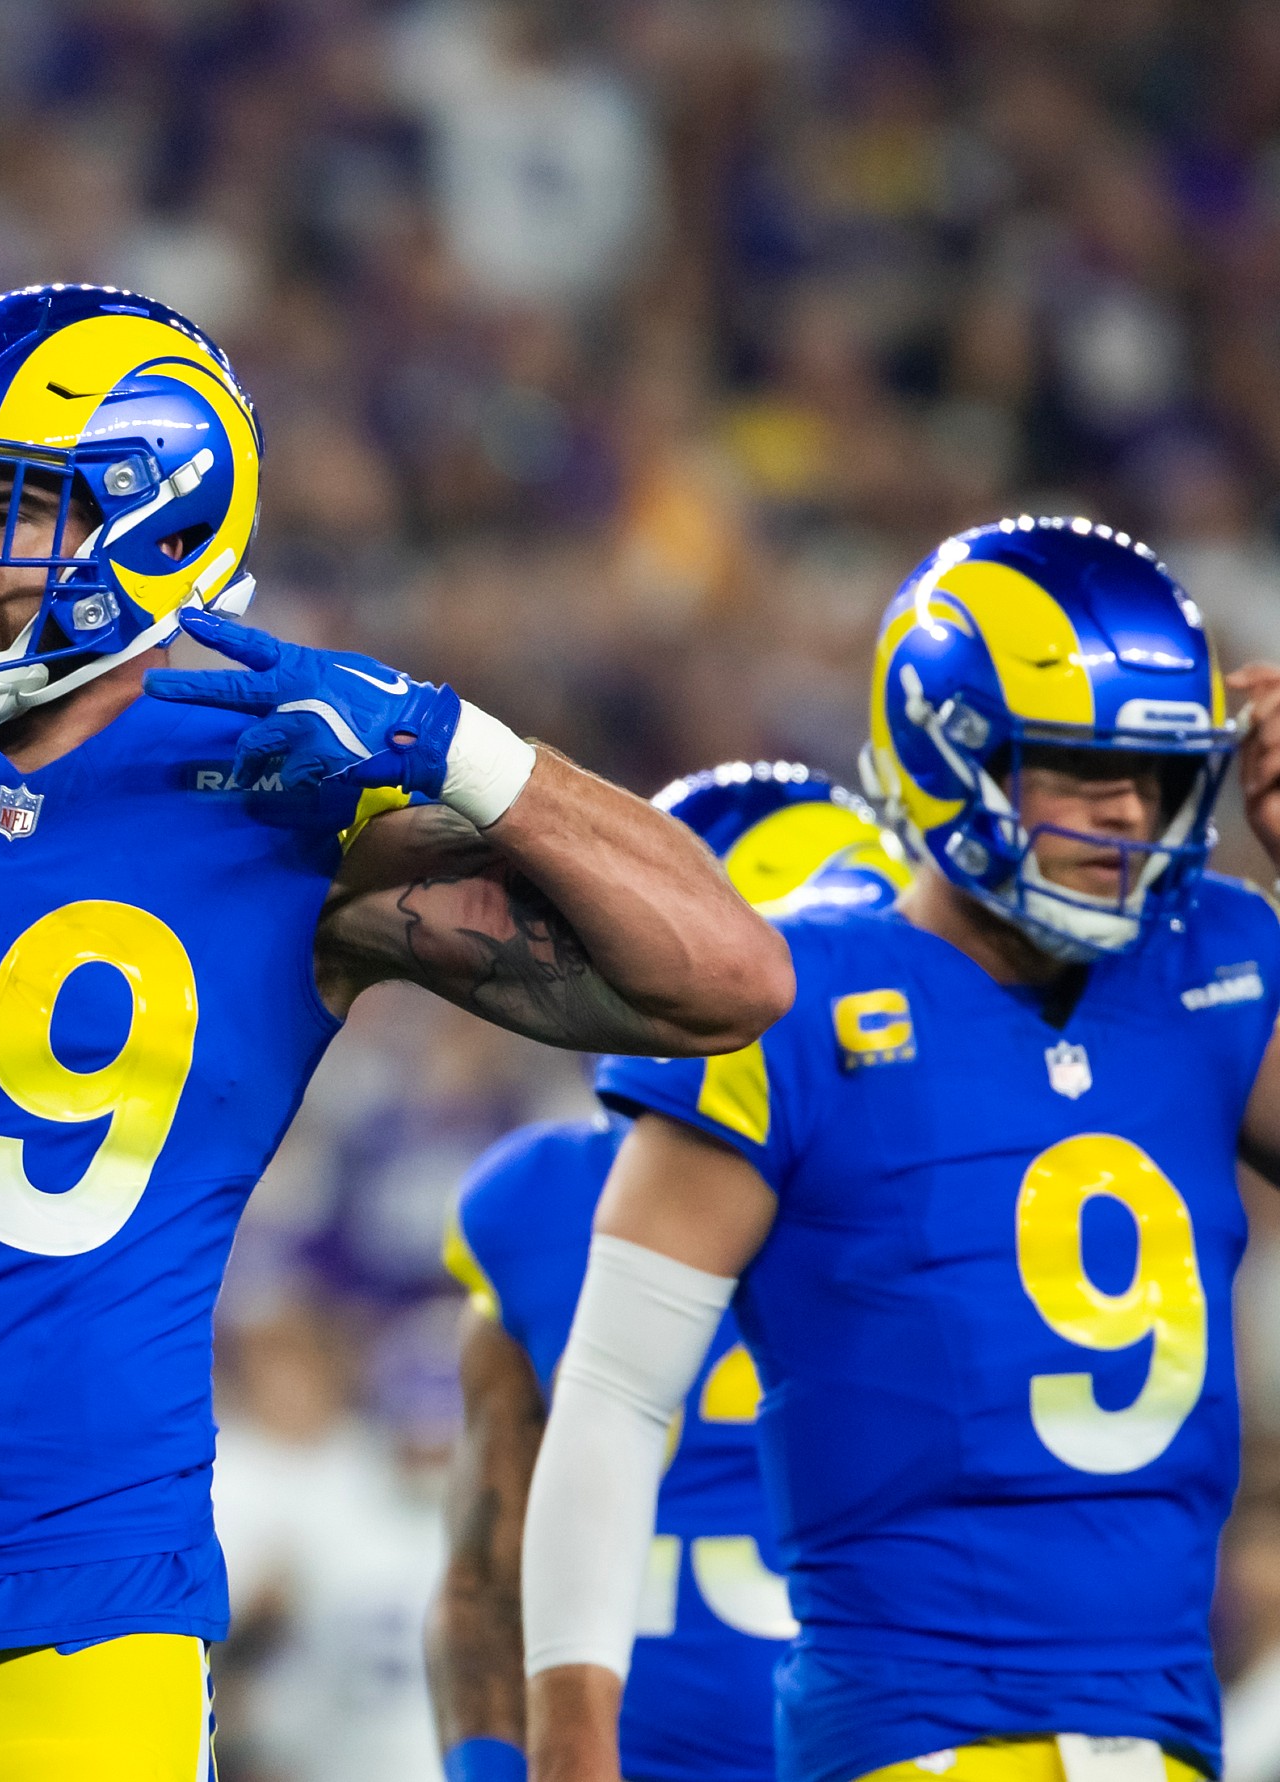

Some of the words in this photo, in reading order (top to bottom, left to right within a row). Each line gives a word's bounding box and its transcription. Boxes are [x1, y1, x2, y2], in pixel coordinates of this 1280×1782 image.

[196, 771, 283, 791] RAM
[0, 807, 29, 831] NFL
[835, 988, 911, 1052] C
[1017, 1132, 1208, 1475] 9
